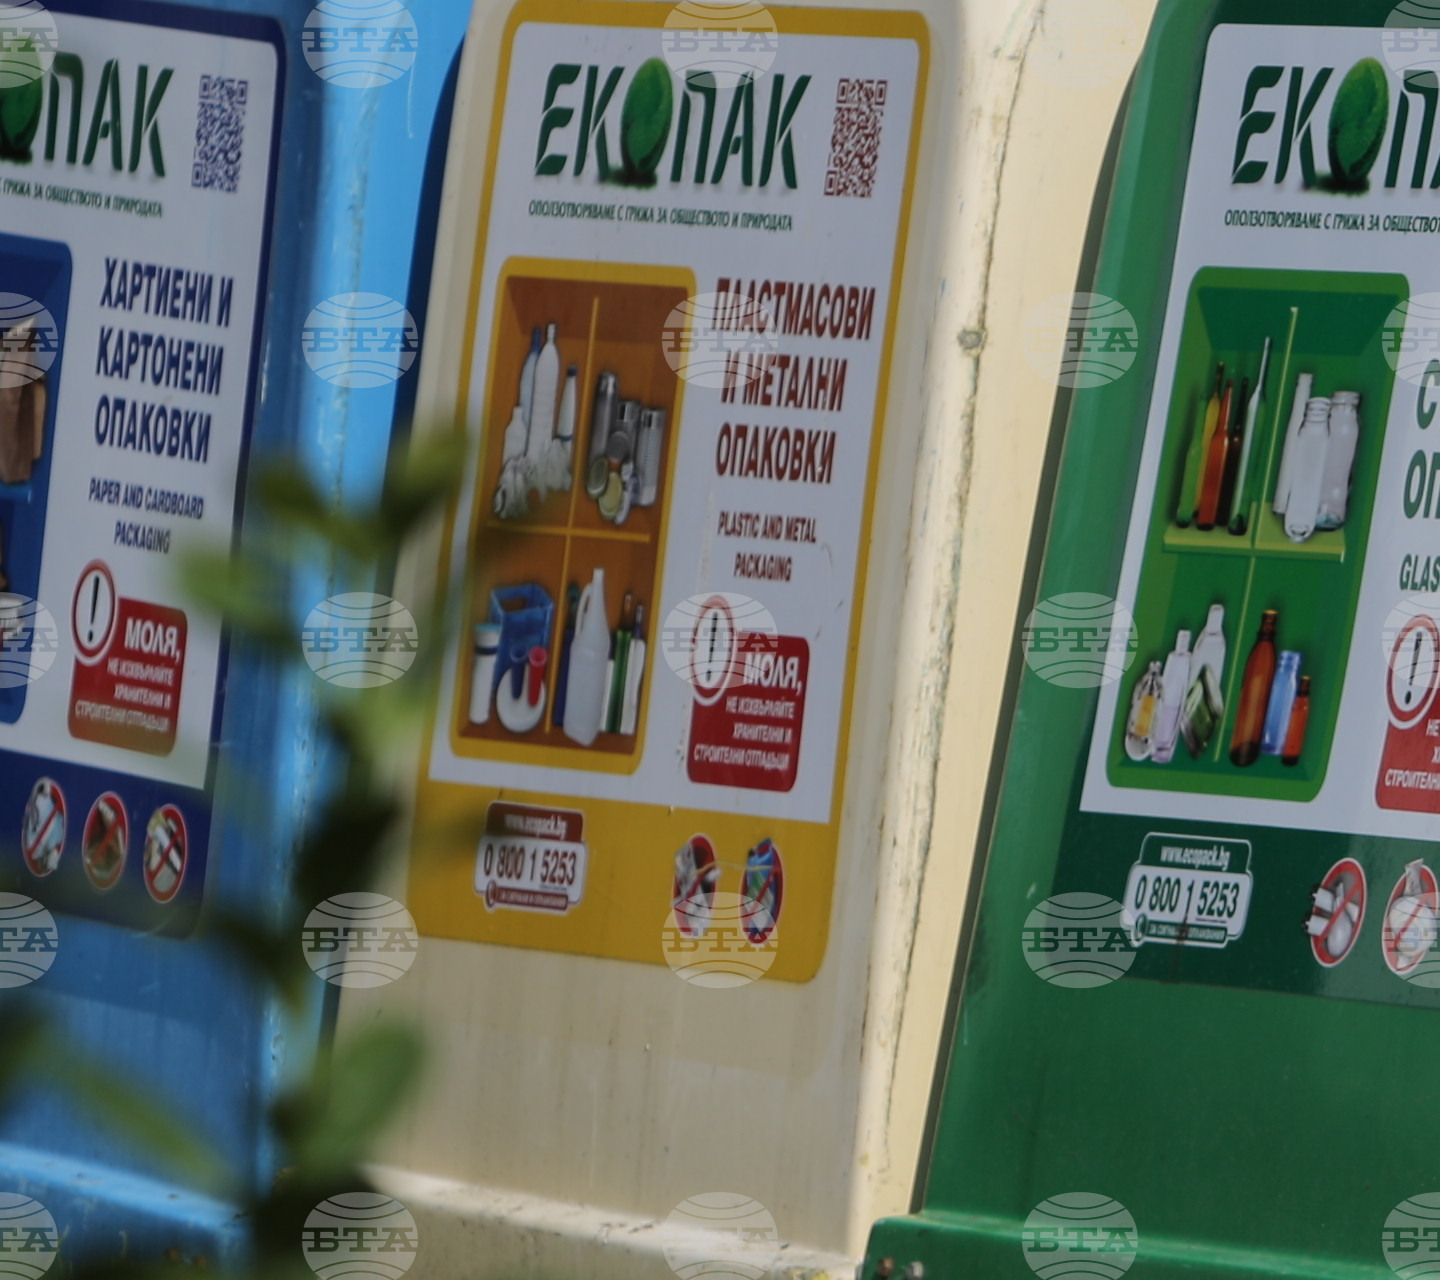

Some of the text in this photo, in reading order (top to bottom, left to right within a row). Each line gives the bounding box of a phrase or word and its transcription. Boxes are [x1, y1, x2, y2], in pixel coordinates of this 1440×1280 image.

[535, 57, 812, 189] ЕКОПАК
[33, 184, 44, 199] ЗА
[45, 185, 101, 208] ОБЩЕСТВОТО
[104, 196, 111, 210] И
[112, 196, 162, 218] ПРИРОДАТА
[529, 200, 792, 232] ОПОЛЗОТВОРЯВАМЕ С ГРИЖА ЗА ОБЩЕСТВОТО И ПРИРОДАТА
[1224, 209, 1322, 229] ОПОЛЗОТВОРЯВАМЕ
[1324, 214, 1330, 229] С
[1332, 213, 1365, 231] ГРИЖА
[1367, 214, 1380, 231] ЗА
[100, 257, 234, 327] ХАРТИЕНИ И
[712, 277, 875, 340] ПЛАСТМАСОВИ
[95, 326, 224, 396] КАРТОНЕНИ
[721, 350, 847, 411] И МЕТАЛНИ
[94, 394, 211, 463] ОПАКОВКИ
[716, 422, 836, 484] ОПАКОВКИ
[89, 477, 204, 520] PAPER AND CARDBOARD
[114, 521, 170, 554] PACKAGING
[718, 511, 816, 543] PLASTIC AND METAL
[734, 553, 792, 581] PACKAGING
[124, 618, 180, 664] МОЛЯ,
[743, 652, 802, 696] МОЛЯ,
[726, 696, 738, 713] НЕ
[785, 728, 792, 744] И
[1426, 719, 1440, 736] НЕ
[484, 843, 576, 886] 0 800 1 5253
[1160, 845, 1231, 872] www.ecopack.bg
[1135, 875, 1239, 918] 0 800 1 5253
